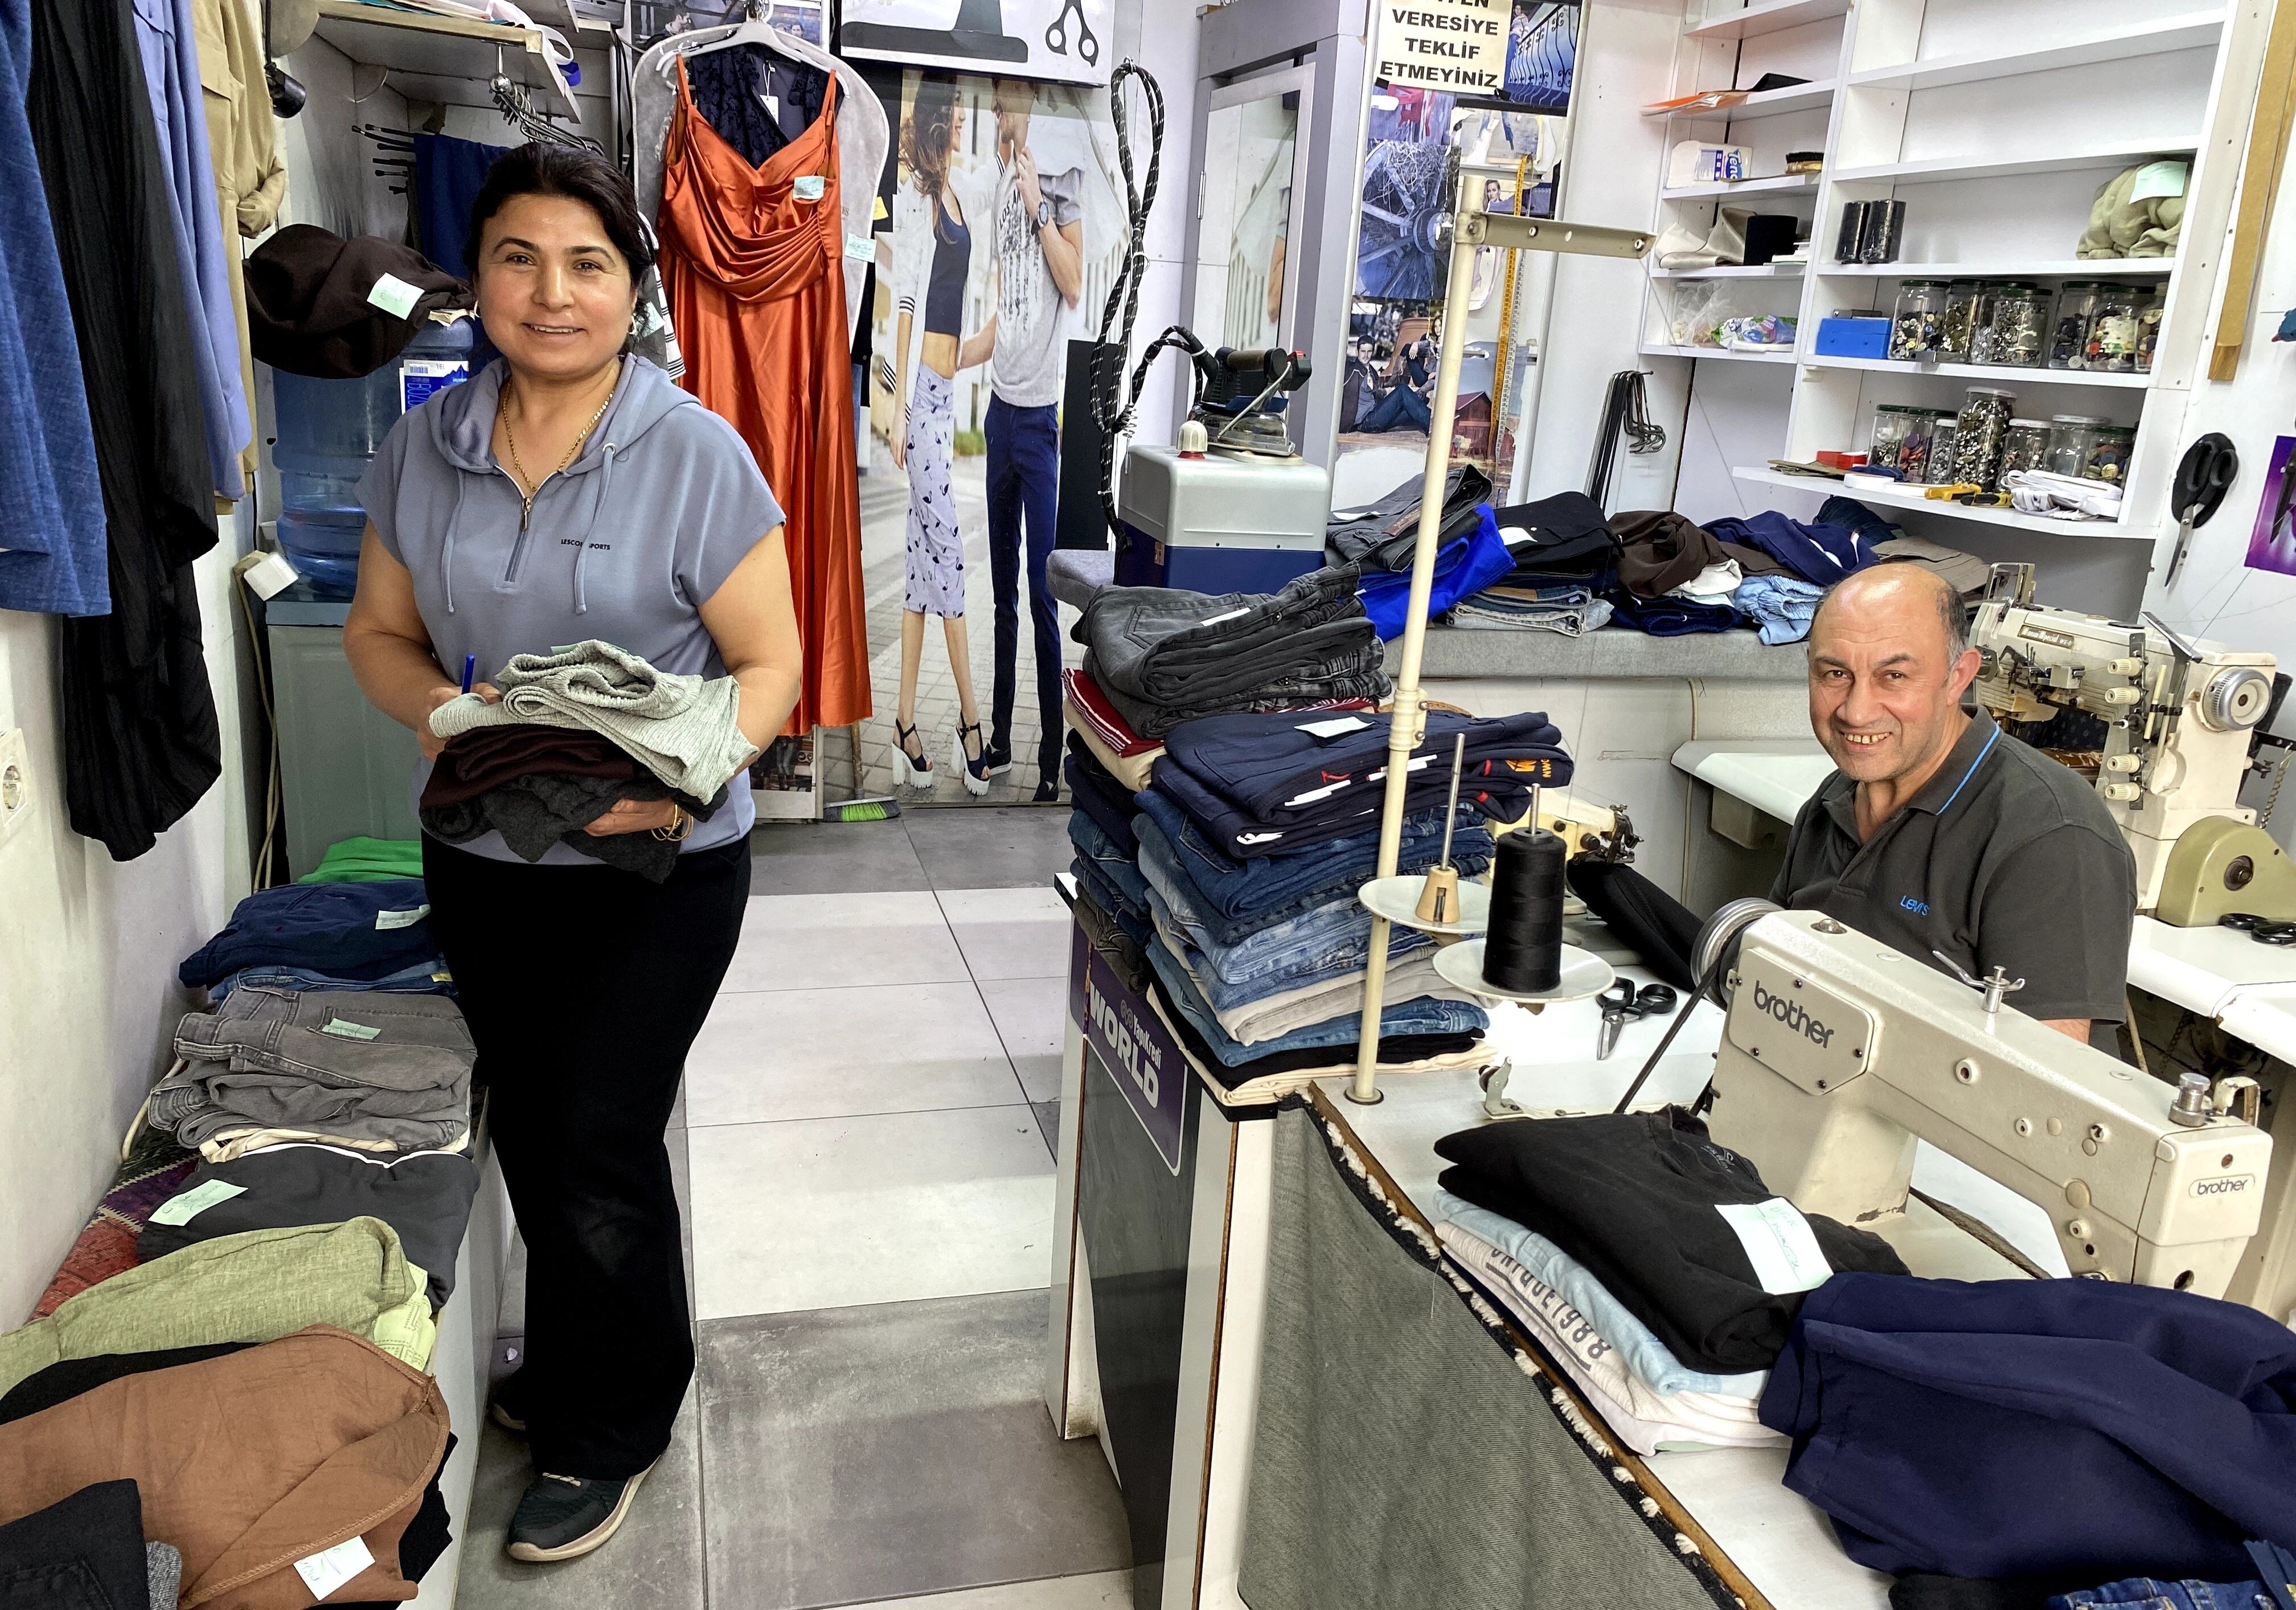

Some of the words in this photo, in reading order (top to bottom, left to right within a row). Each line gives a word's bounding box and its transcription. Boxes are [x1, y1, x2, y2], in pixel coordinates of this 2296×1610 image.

[1392, 9, 1498, 35] VERESİYE
[1405, 38, 1480, 59] TEKLİF
[1380, 61, 1498, 87] ETMEYİNİZ
[1754, 980, 1835, 1049] brother
[1090, 980, 1159, 1108] WORLD
[2197, 1179, 2248, 1195] brother
